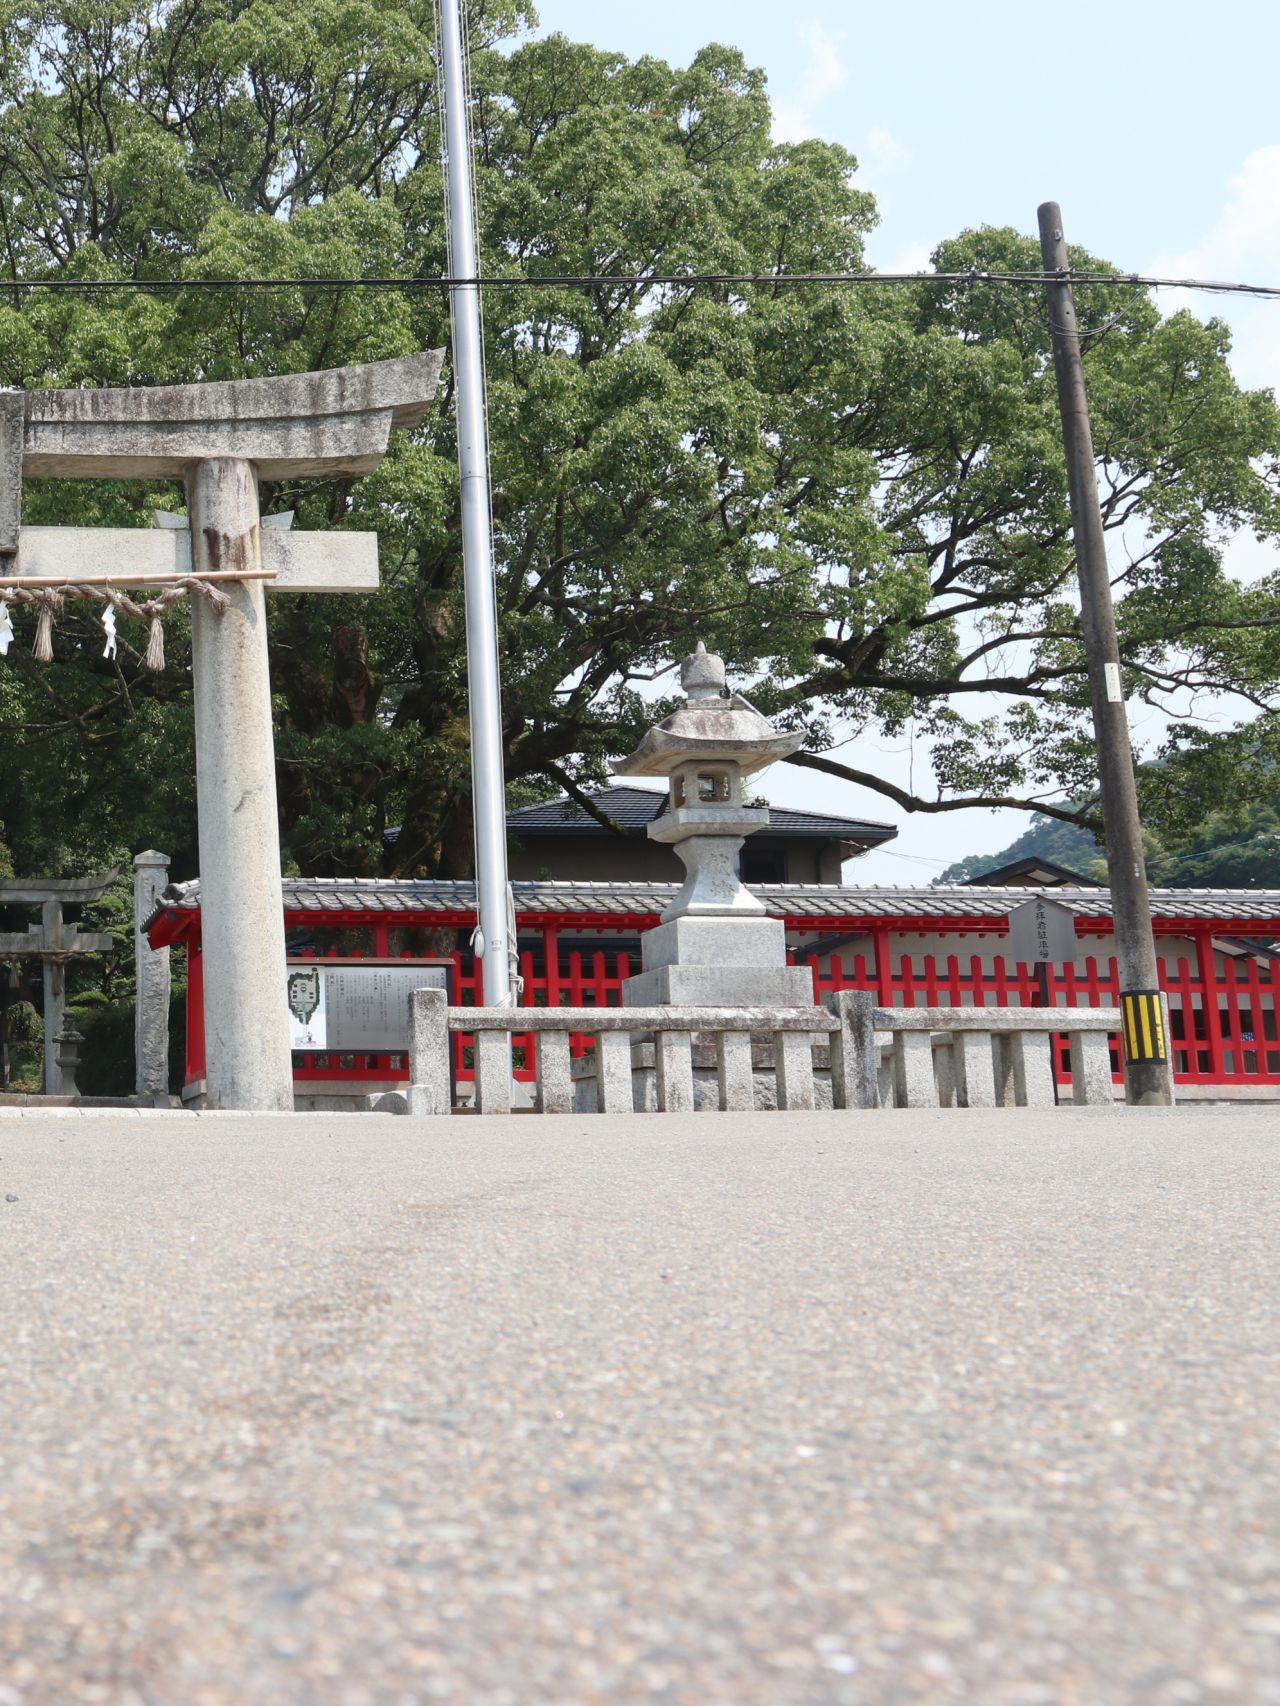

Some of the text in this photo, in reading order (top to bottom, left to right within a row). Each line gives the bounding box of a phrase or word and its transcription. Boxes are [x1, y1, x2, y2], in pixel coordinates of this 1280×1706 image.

[1035, 902, 1049, 959] 参拝者駐車場
